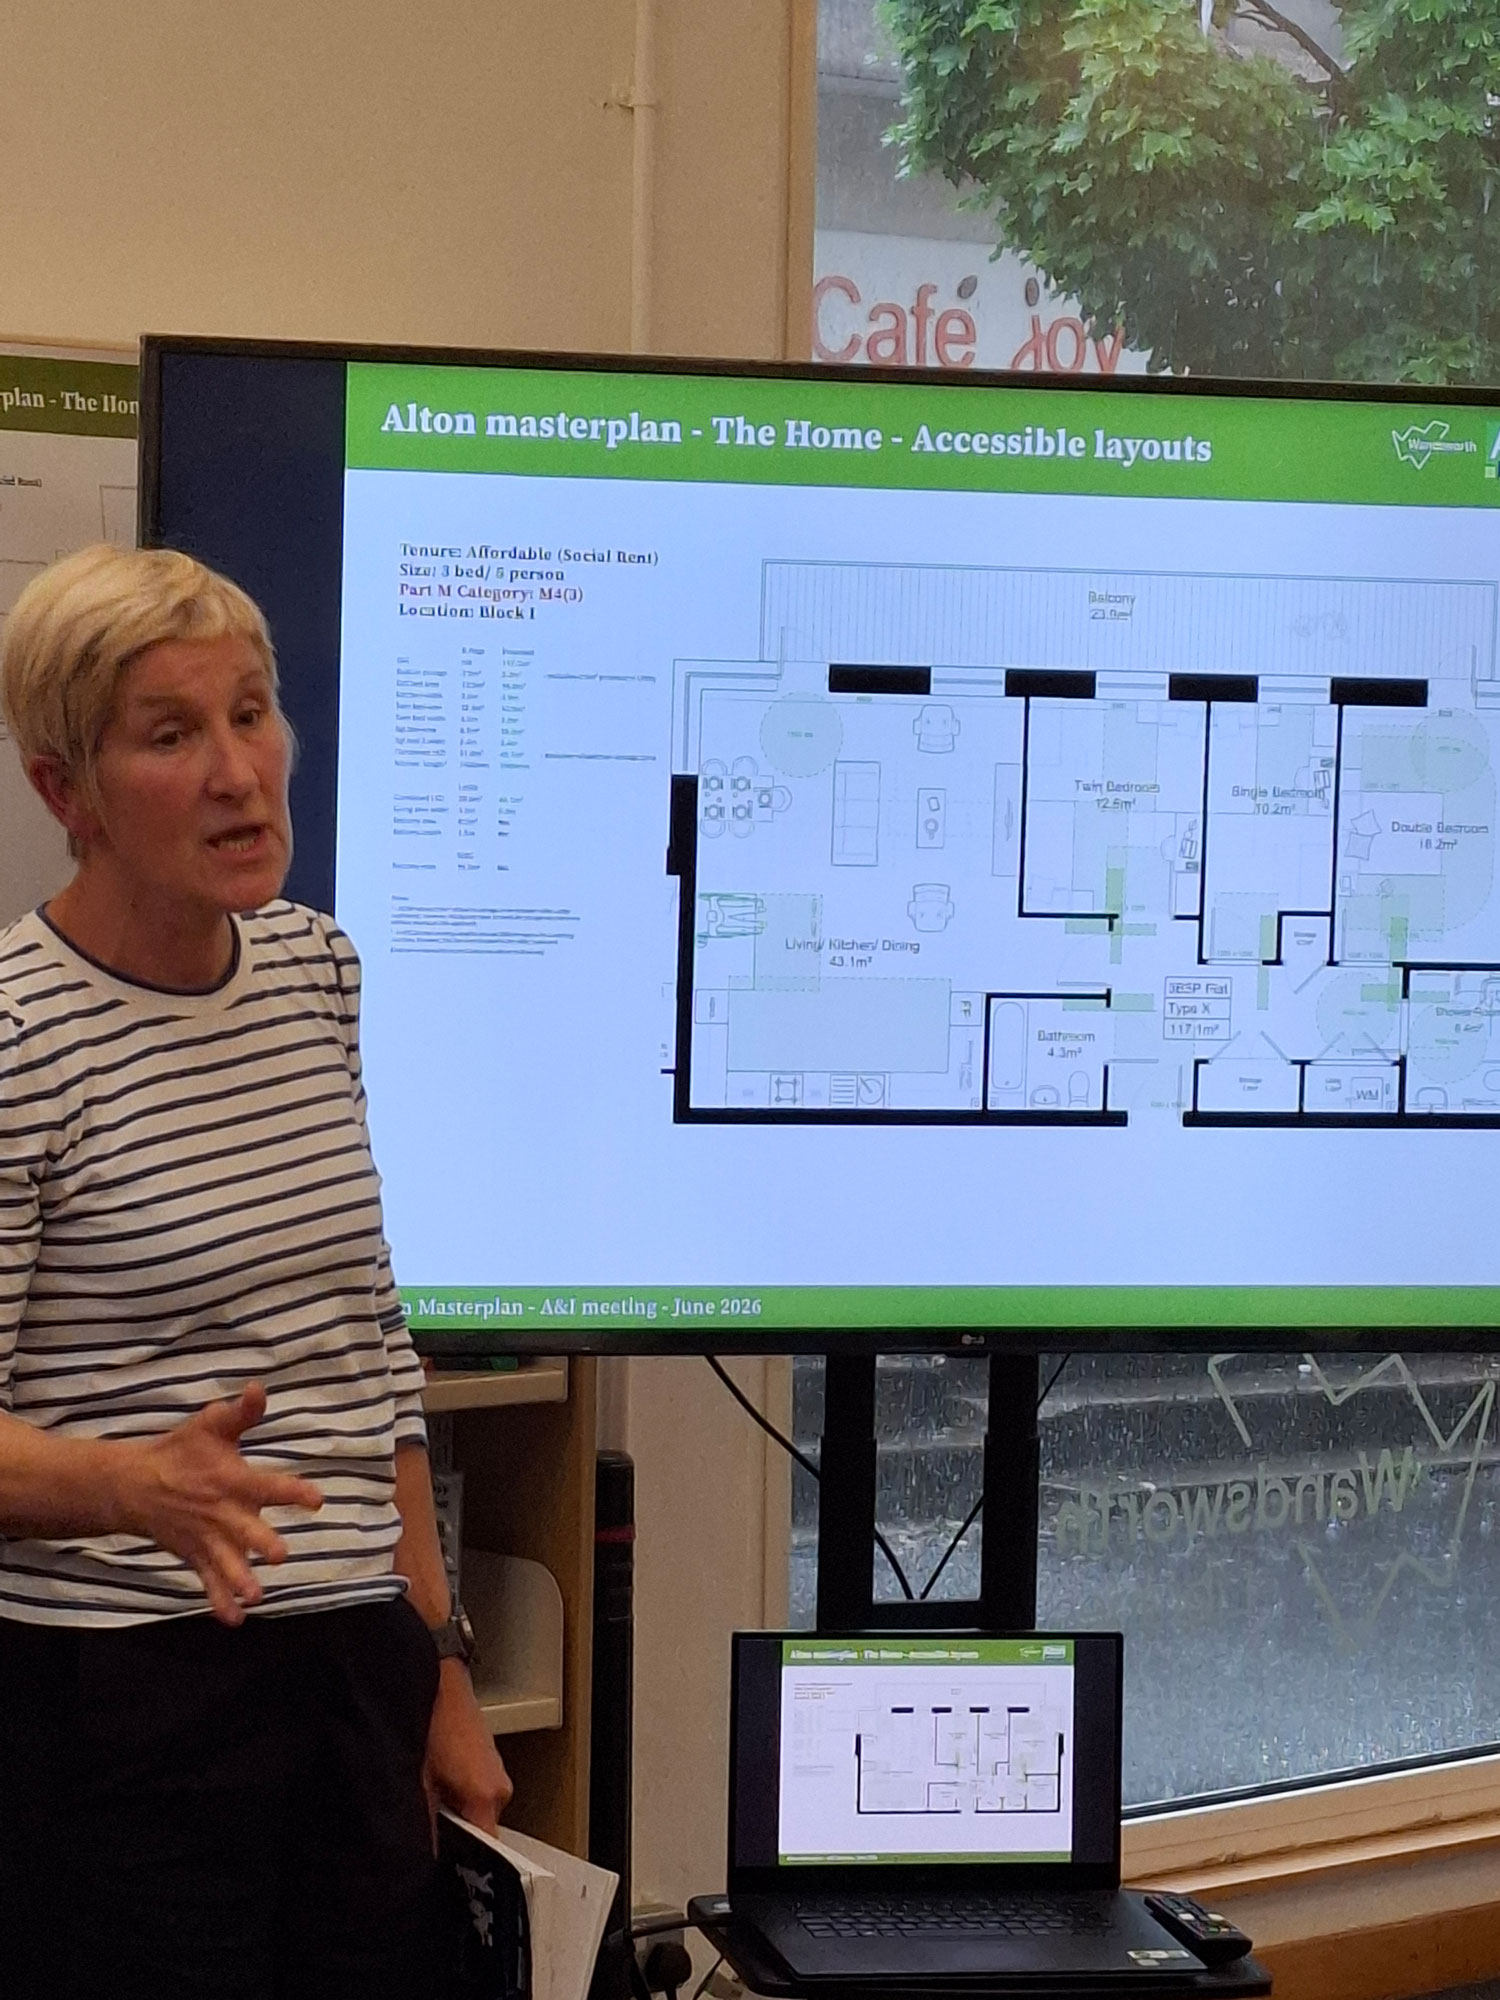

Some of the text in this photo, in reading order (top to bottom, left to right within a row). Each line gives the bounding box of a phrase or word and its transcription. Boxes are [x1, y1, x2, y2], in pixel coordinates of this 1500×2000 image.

[812, 275, 977, 368] Café
[61, 391, 98, 412] The
[381, 403, 476, 435] Alton
[486, 412, 682, 449] masterplan
[712, 415, 777, 447] The
[784, 420, 882, 451] Home
[911, 424, 1086, 459] Accessible
[1094, 429, 1212, 467] layouts
[400, 543, 659, 567] Tenure: Affordable (Social Rent)
[454, 565, 491, 581] bed/
[509, 570, 564, 583] person
[399, 583, 432, 598] Part
[438, 584, 451, 597] M
[457, 584, 534, 604] Category:
[1088, 590, 1137, 604] Balcony
[398, 602, 474, 618] Location:
[479, 606, 524, 620] Block
[1106, 780, 1161, 793] Bedroom
[1391, 821, 1489, 834] Double Bedroom
[882, 939, 920, 954] Dining
[1168, 1002, 1211, 1016] Type X
[1037, 1029, 1096, 1042] Bathroom
[418, 1297, 523, 1321] Masterplan
[581, 1298, 658, 1319] meeting
[670, 1297, 715, 1317] June
[719, 1298, 762, 1316] 2026
